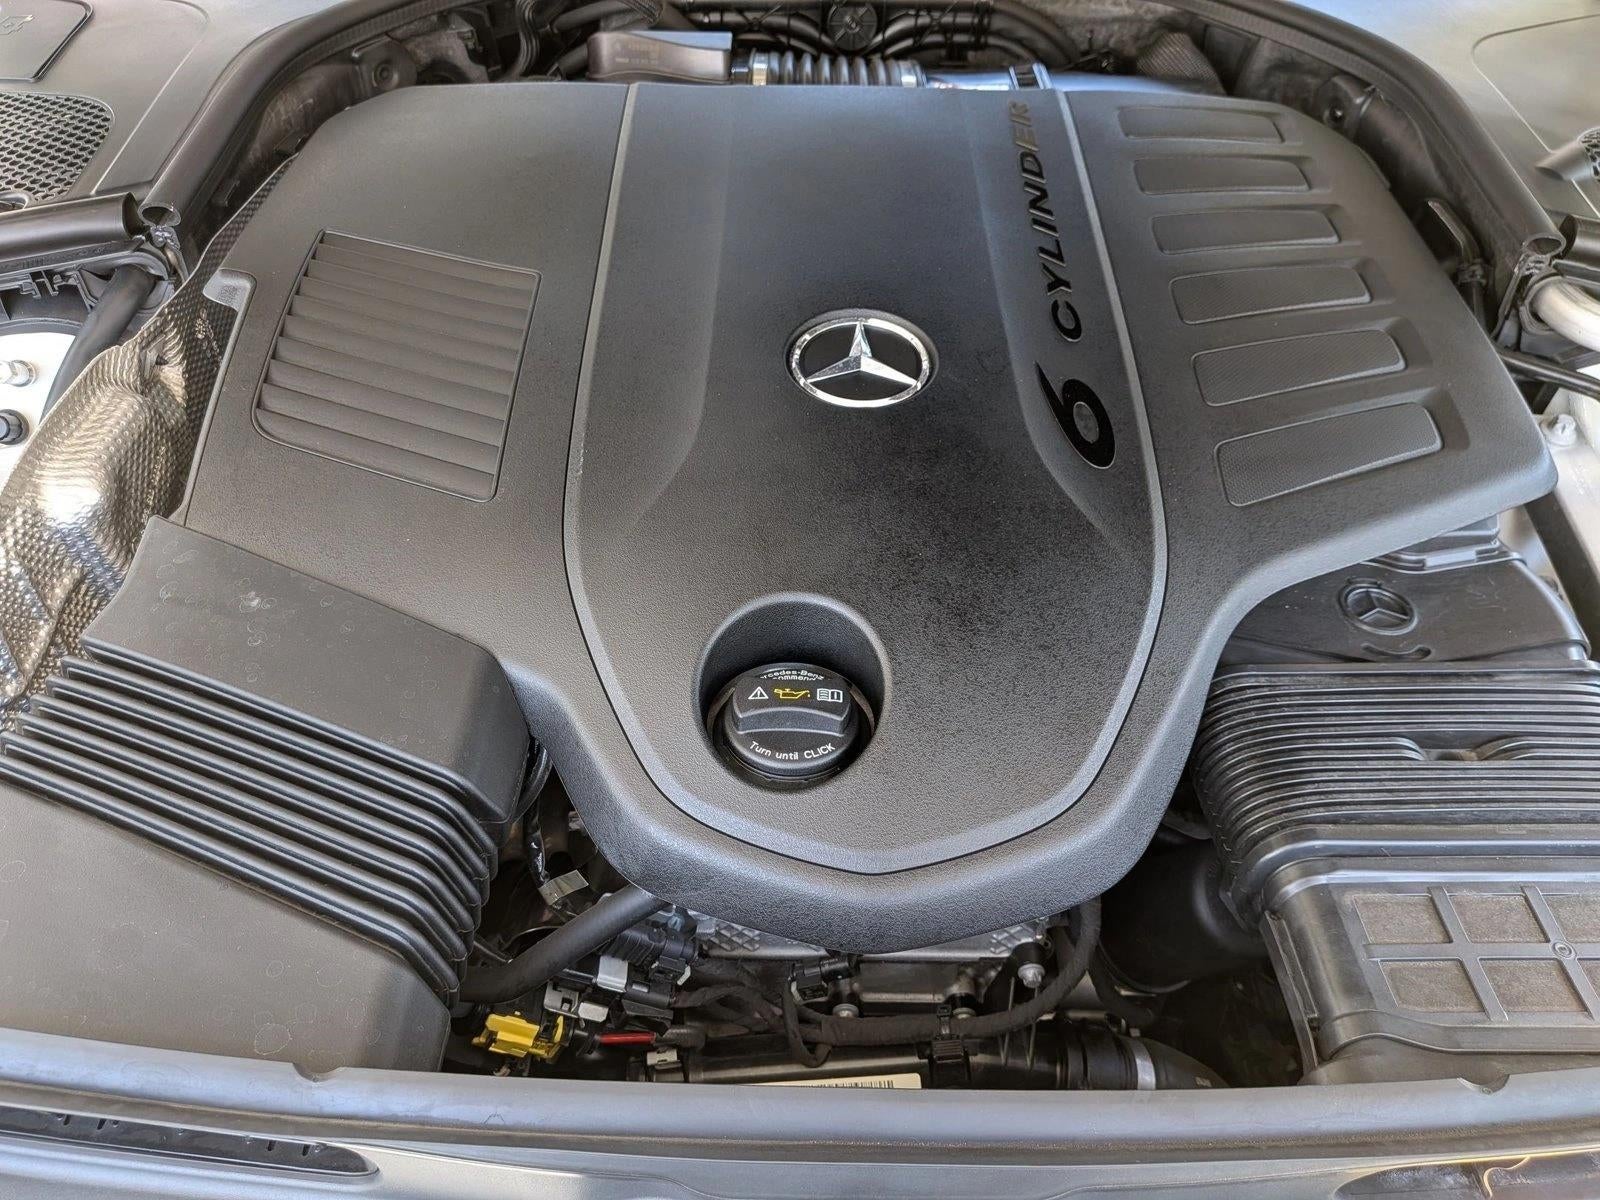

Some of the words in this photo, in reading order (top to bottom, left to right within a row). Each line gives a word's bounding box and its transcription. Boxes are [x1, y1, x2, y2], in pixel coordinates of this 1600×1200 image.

[1008, 100, 1083, 342] CYLINDER
[1034, 361, 1117, 469] 6
[749, 740, 772, 757] Turn
[775, 751, 799, 761] until
[803, 742, 836, 759] CLICK
